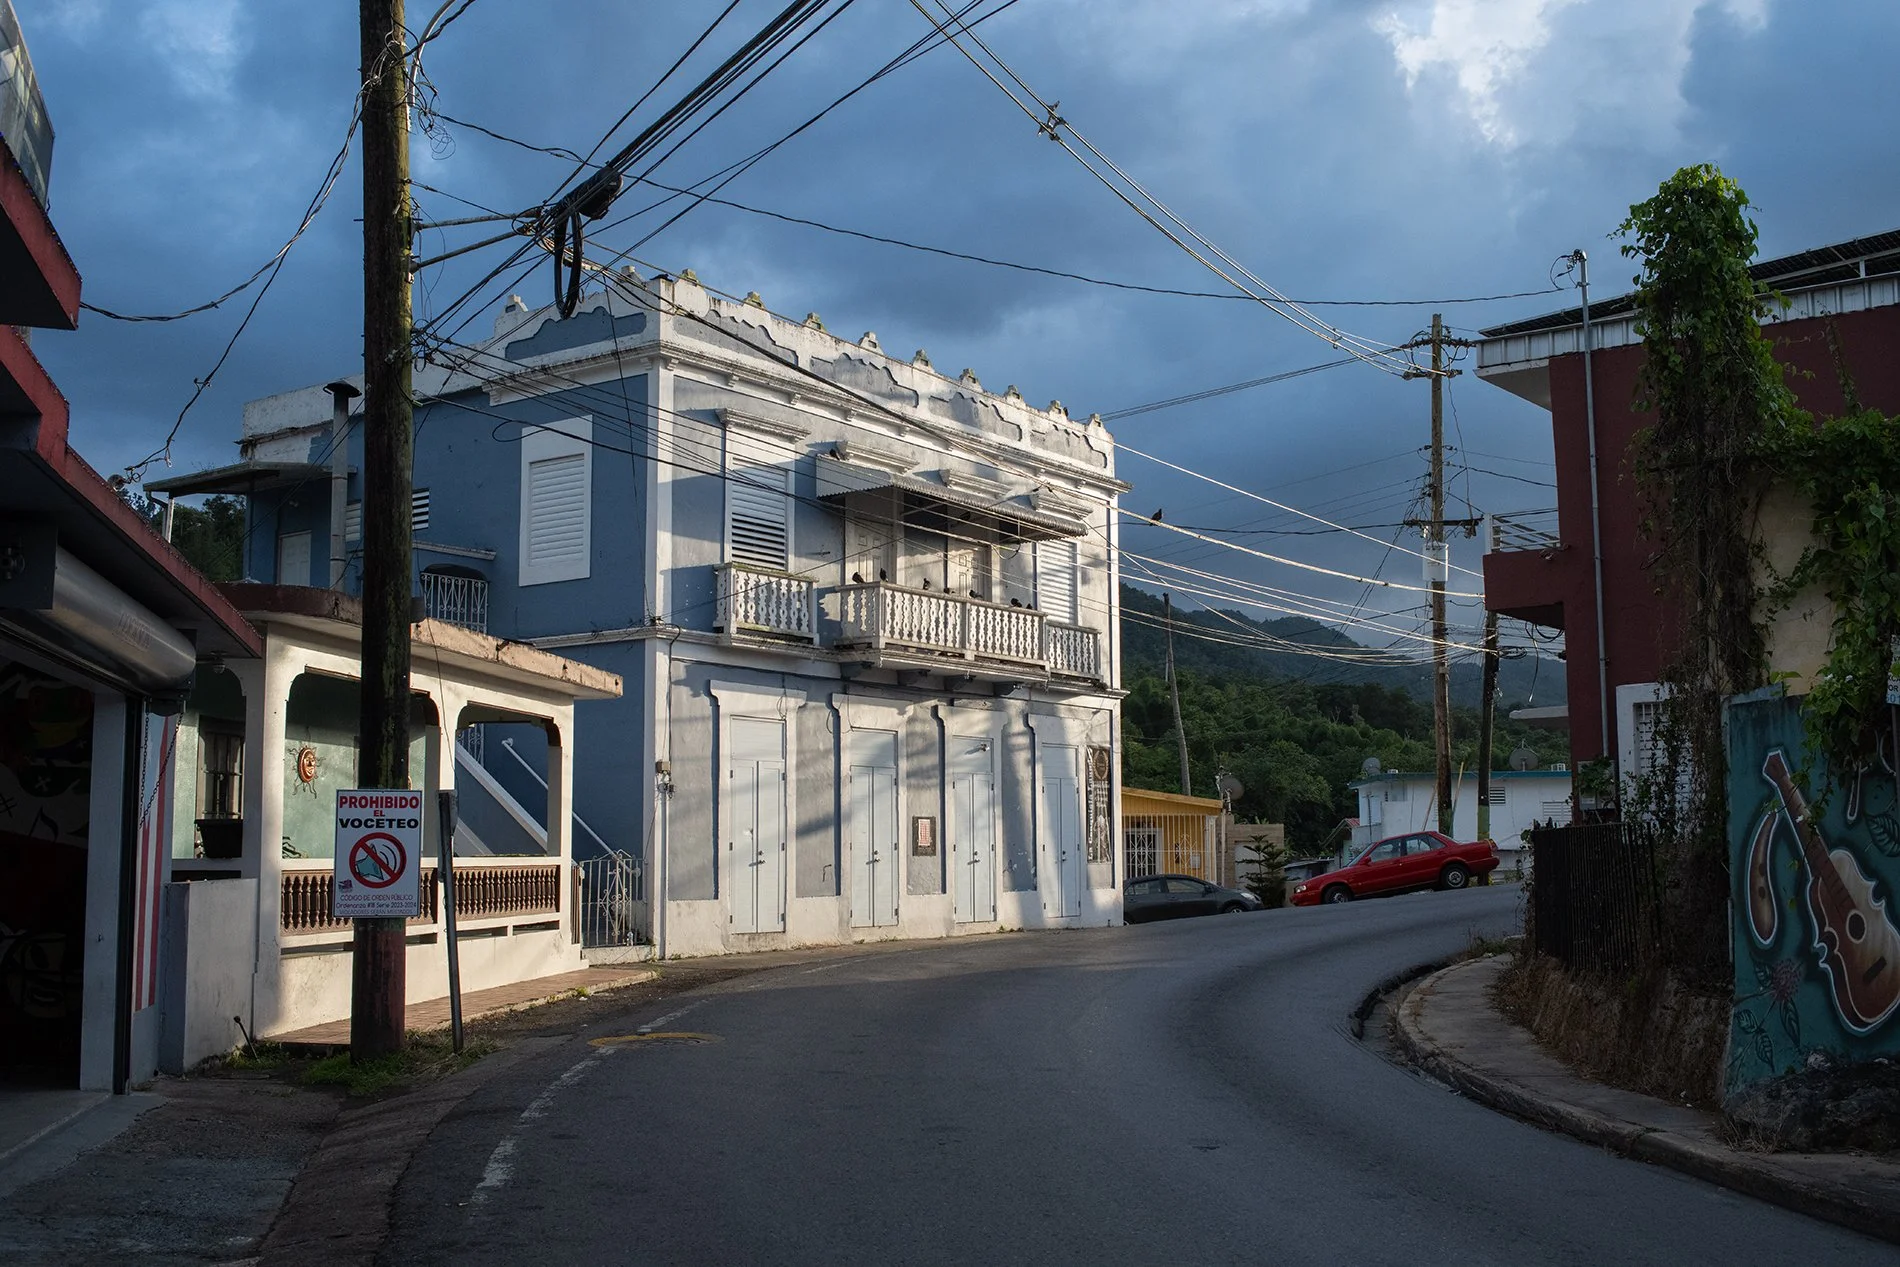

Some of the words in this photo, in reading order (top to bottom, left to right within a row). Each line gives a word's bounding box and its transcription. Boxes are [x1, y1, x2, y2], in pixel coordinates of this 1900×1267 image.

[339, 795, 420, 809] PROHIBIDO
[373, 809, 386, 817] EL
[338, 818, 419, 829] VOCETEO
